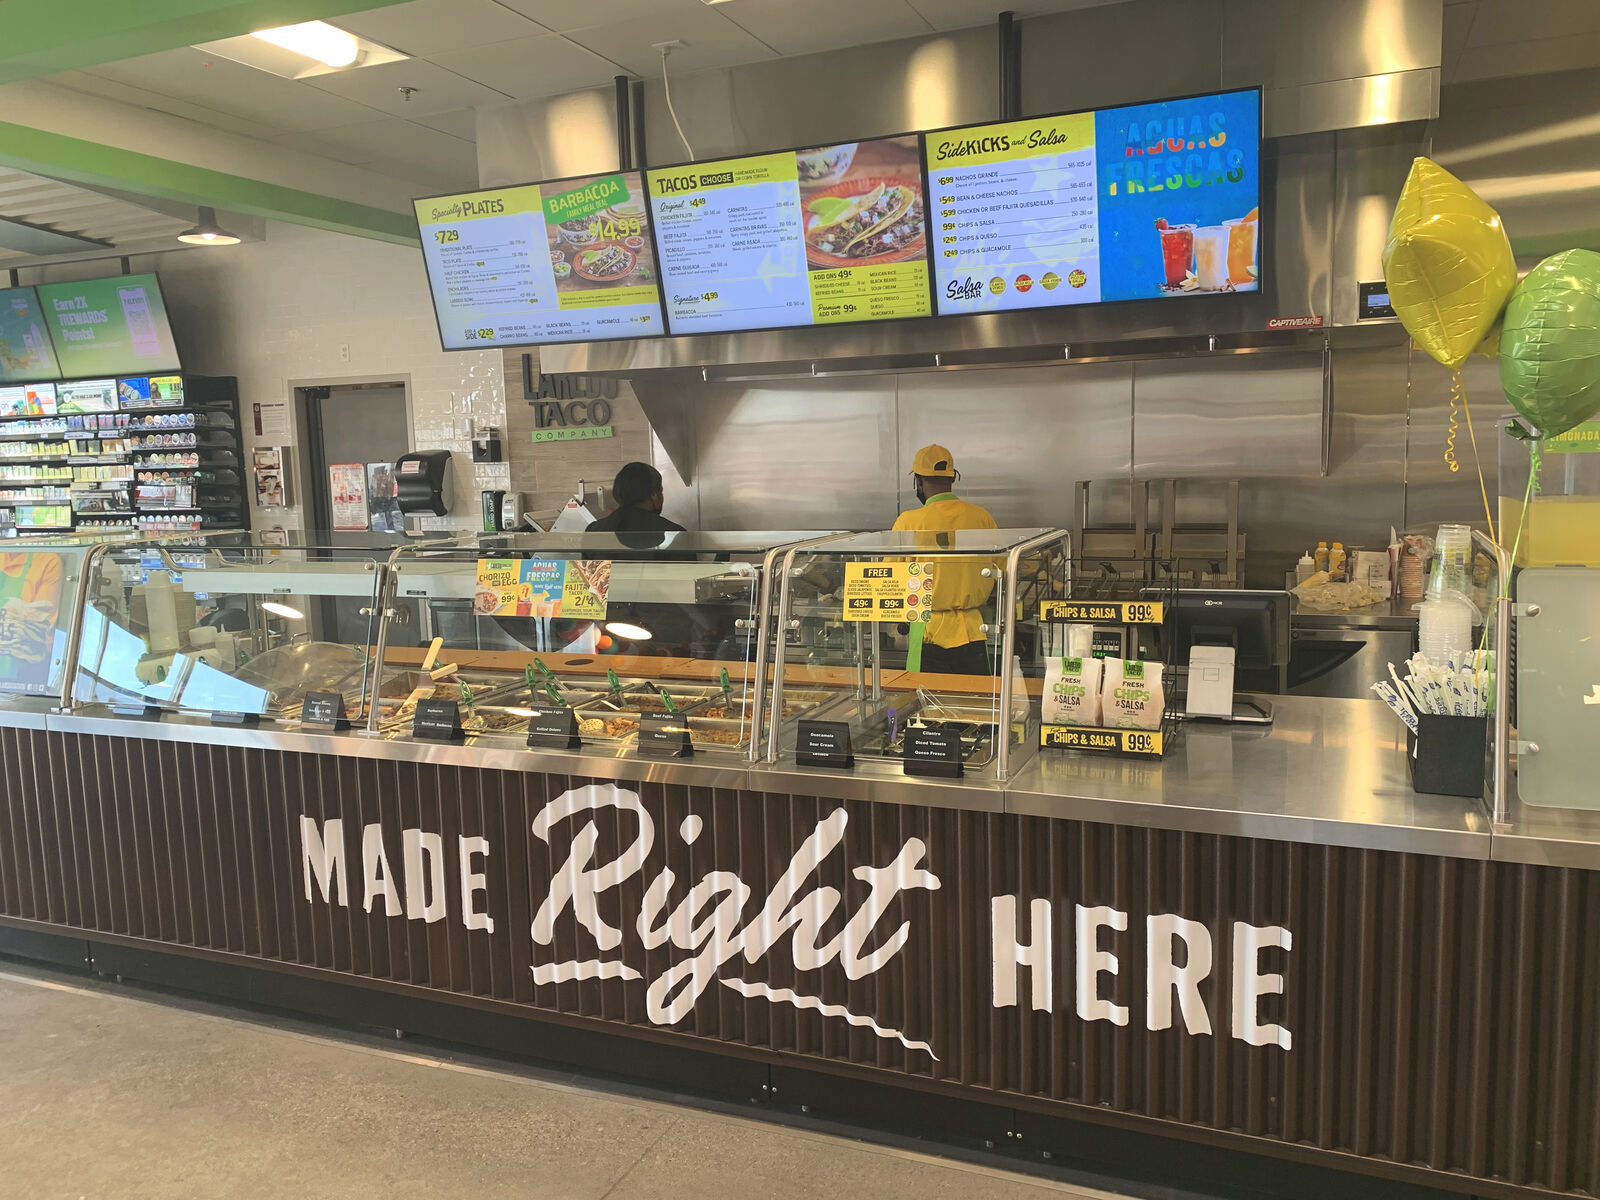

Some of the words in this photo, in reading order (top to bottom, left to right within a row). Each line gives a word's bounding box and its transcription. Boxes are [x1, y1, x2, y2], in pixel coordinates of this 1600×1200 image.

[1011, 136, 1026, 146] and
[1027, 128, 1068, 149] Salsa
[1126, 112, 1226, 157] AGUAS
[977, 171, 998, 179] GRANDE
[1107, 149, 1245, 196] FRESCAS
[656, 175, 697, 194] TACOS
[702, 173, 731, 185] CHOOSE
[549, 181, 620, 214] BARBACOA
[432, 203, 462, 221] Specialty
[462, 199, 505, 217] PLATES
[659, 200, 685, 213] Original
[957, 207, 980, 215] CHICKEN
[1002, 202, 1019, 210] FAJITA
[1020, 199, 1054, 209] QUESADILLAS
[588, 217, 641, 242] $14.99
[981, 245, 1011, 254] GUACAMOLE
[946, 277, 984, 300] Salsa
[673, 294, 700, 305] Signature
[965, 291, 982, 300] BAR
[53, 299, 74, 311] Earn
[74, 296, 88, 309] 2X
[818, 303, 841, 311] Premium
[1269, 317, 1321, 327] CAPTIVEAIRE
[529, 399, 612, 428] TACO
[536, 429, 608, 441] COMPANY
[532, 562, 557, 571] AGUAS
[868, 569, 888, 577] FREE
[479, 572, 511, 582] CHORIZO
[527, 572, 560, 581] FRESCAS
[501, 595, 515, 603] 99¢
[854, 599, 868, 607] 49¢
[885, 599, 899, 607] 99¢
[1053, 607, 1078, 618] CHIPS
[1080, 608, 1088, 618] &
[1089, 608, 1116, 619] SALSA
[1128, 604, 1152, 621] 99¢
[1053, 682, 1086, 697] CHIPS
[1114, 688, 1150, 702] CHIPS
[1059, 695, 1081, 706] SALSA
[1120, 700, 1144, 710] SALSA
[1053, 732, 1078, 744] CHIPS
[1081, 733, 1088, 744] &
[1090, 734, 1116, 747] SALSA
[1128, 734, 1152, 751] 99¢
[300, 815, 494, 933] MADE
[531, 783, 942, 1025] Right
[991, 894, 1292, 1050] HERE
